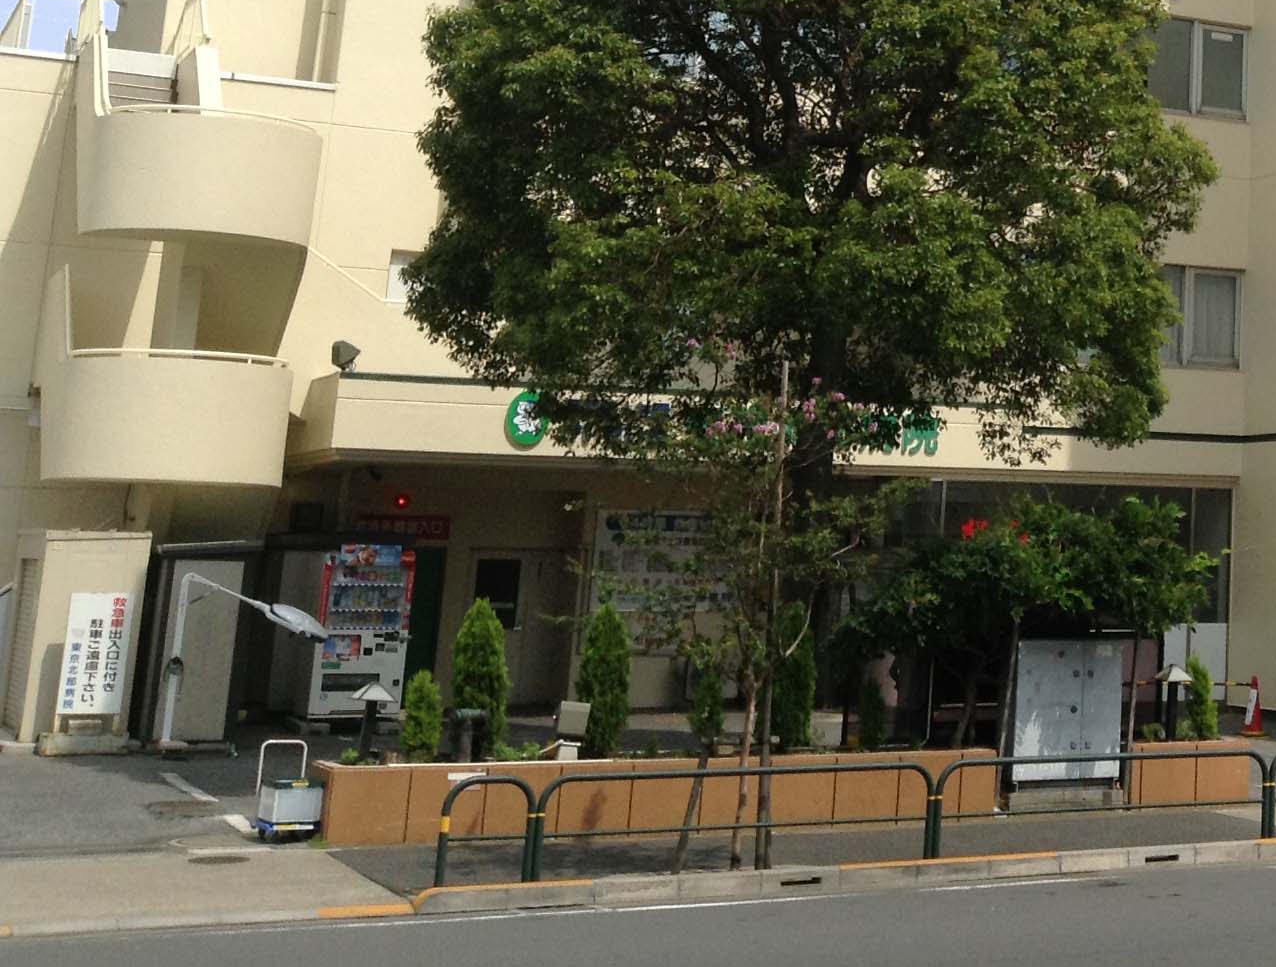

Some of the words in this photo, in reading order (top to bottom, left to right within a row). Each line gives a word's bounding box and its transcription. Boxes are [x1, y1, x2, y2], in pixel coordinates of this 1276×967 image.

[62, 642, 83, 709] 東京北部病院
[103, 597, 128, 693] 救急車出入口に付き
